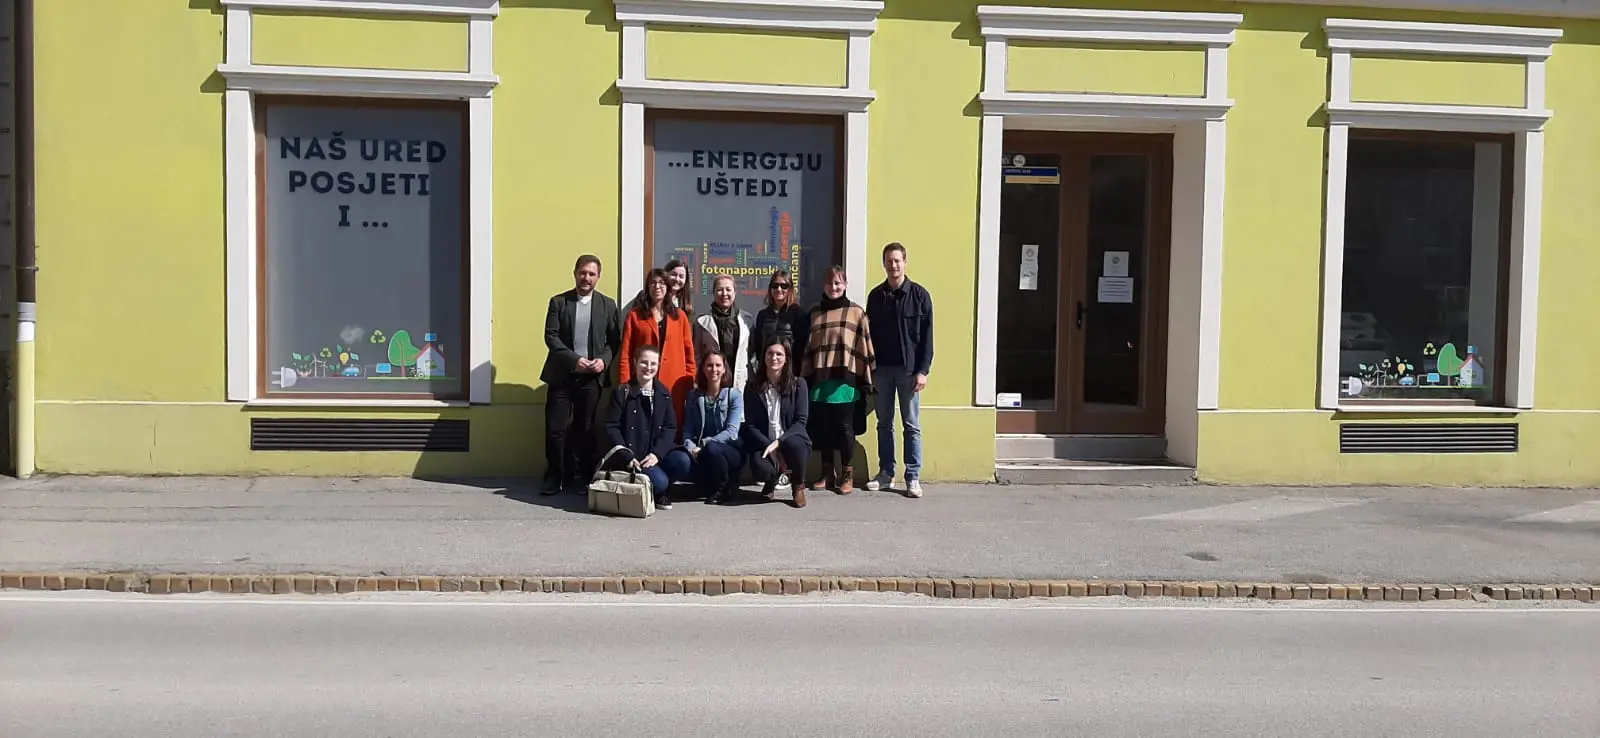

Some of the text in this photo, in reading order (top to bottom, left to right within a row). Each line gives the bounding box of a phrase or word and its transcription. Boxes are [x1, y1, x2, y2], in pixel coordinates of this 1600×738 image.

[280, 131, 447, 163] NAŠ URED
[668, 150, 822, 171] ...ENERGIJU
[289, 171, 430, 195] POSJETI
[697, 172, 788, 197] UŠTEDI
[338, 205, 350, 227] I
[780, 211, 792, 261] energija
